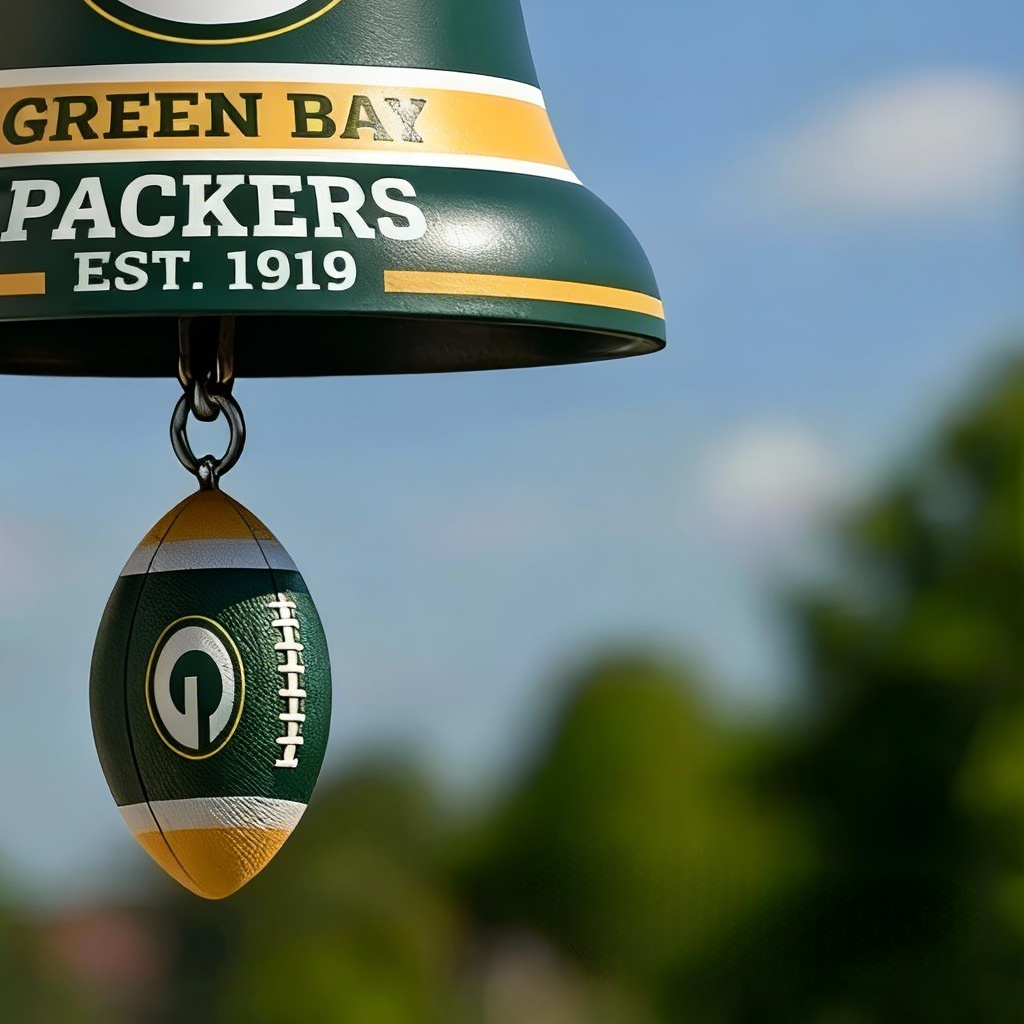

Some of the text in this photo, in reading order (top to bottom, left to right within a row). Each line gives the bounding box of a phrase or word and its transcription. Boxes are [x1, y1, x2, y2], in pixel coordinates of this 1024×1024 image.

[2, 92, 427, 145] GREEN BAY
[0, 174, 428, 242] PACKERS
[73, 250, 357, 292] EST. 1919
[153, 625, 235, 750] G
